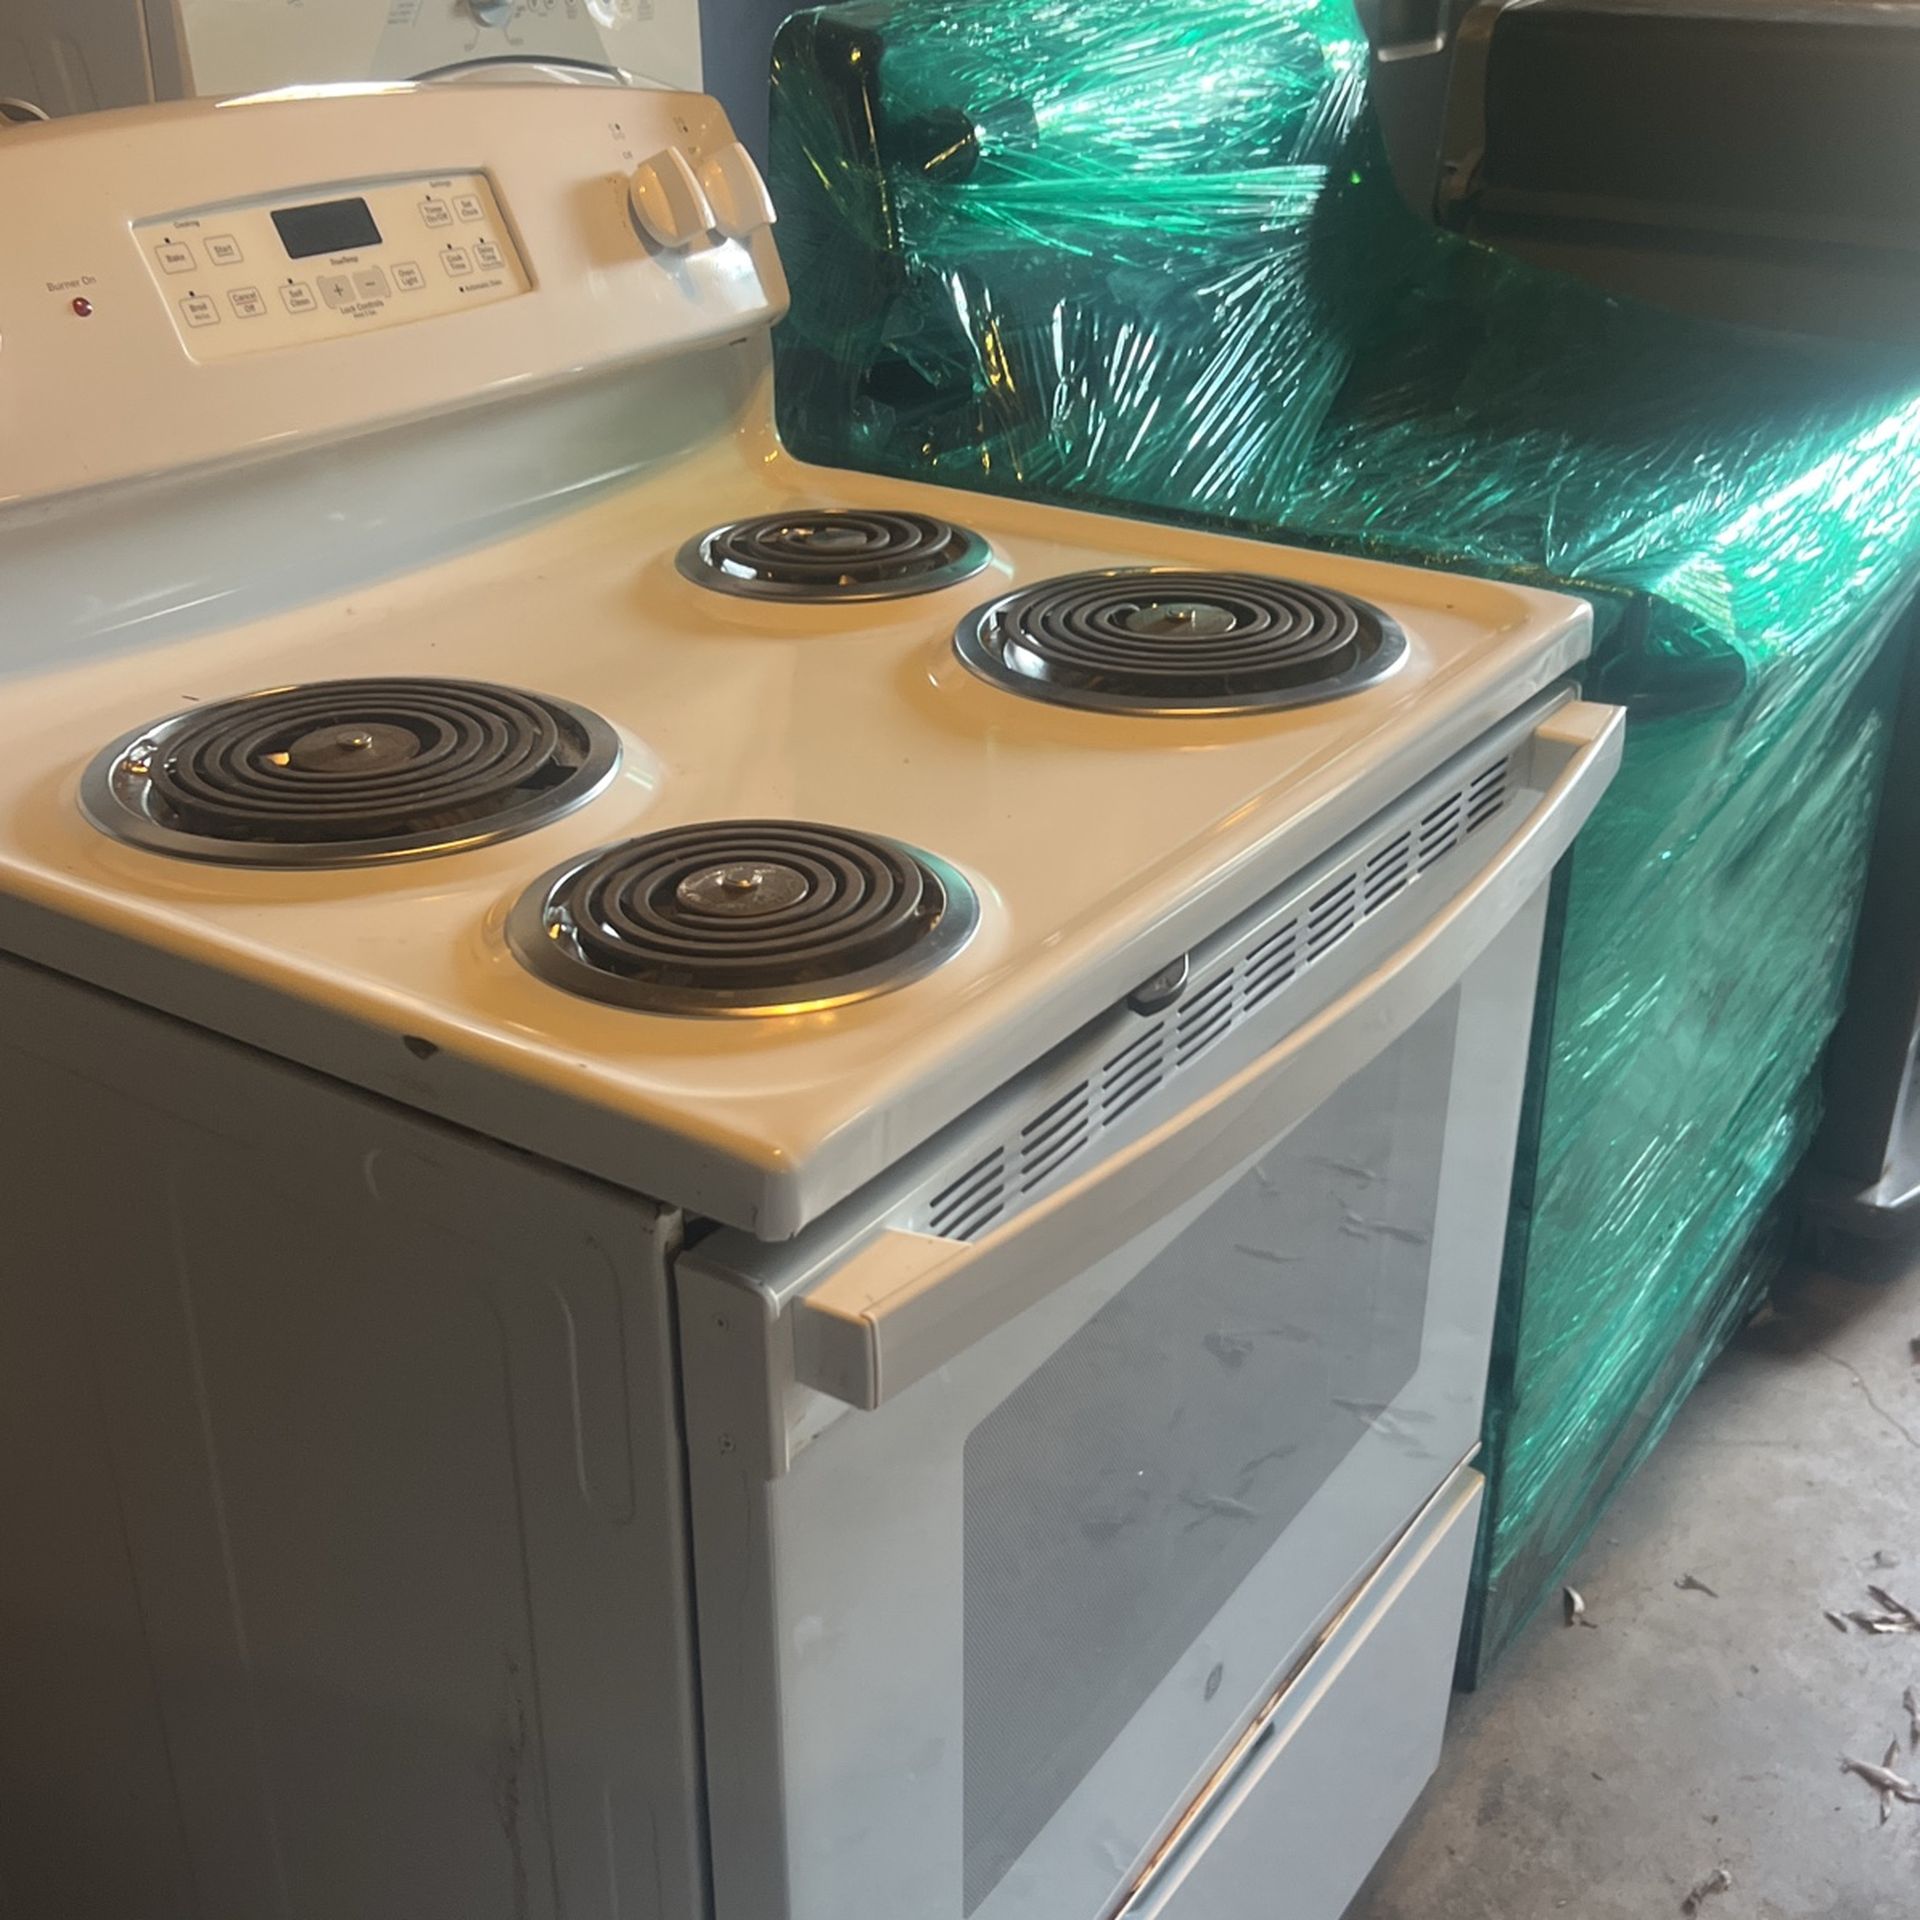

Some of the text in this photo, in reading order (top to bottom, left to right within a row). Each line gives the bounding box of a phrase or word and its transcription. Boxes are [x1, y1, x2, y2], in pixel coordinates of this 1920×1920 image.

[213, 245, 232, 254] Start
[165, 255, 185, 263] Bake
[46, 275, 97, 292] Burner On
[231, 292, 257, 301] Cancel
[243, 304, 256, 313] Off
[339, 300, 385, 315] Lock Controls
